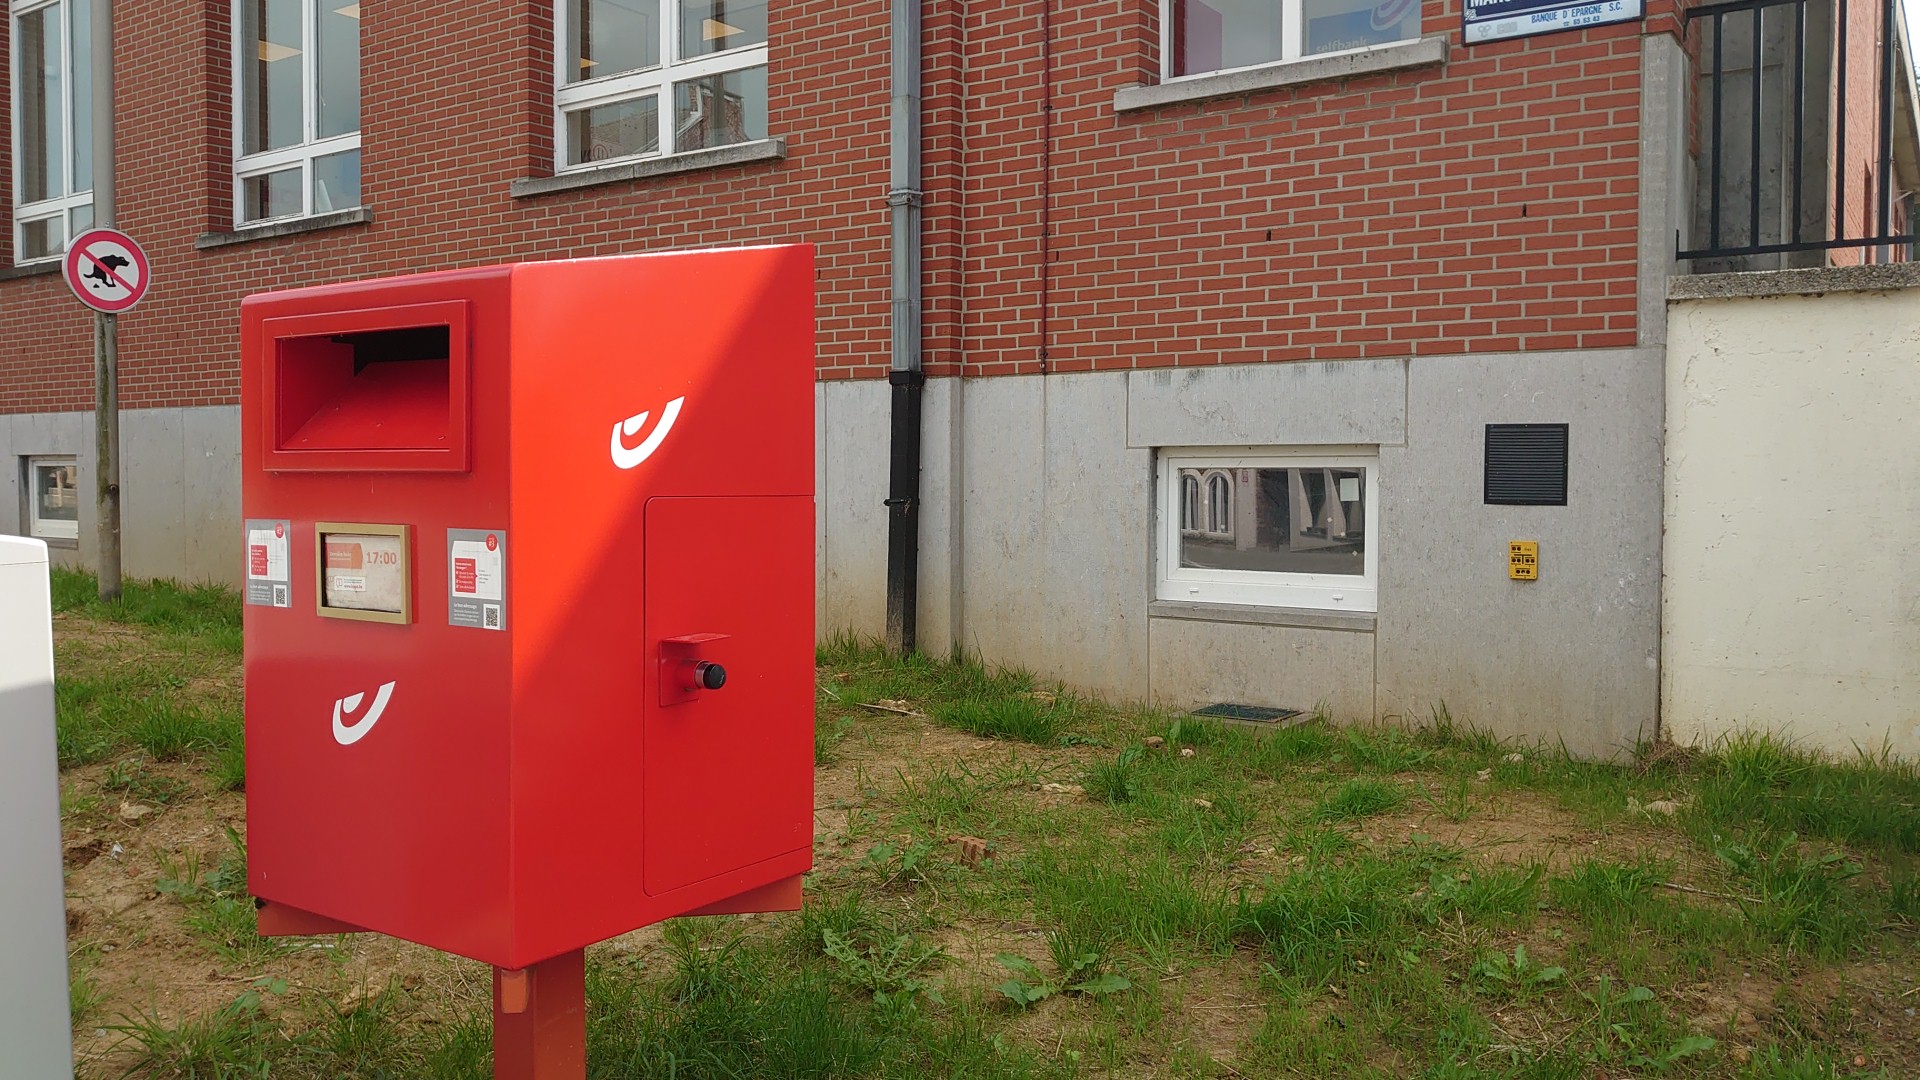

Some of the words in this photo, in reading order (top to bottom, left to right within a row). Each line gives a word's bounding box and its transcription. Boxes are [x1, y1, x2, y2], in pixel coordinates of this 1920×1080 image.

[1531, 12, 1558, 24] BANQUE
[1608, 2, 1623, 12] S.C.
[1316, 36, 1367, 53] selfbank
[366, 551, 397, 565] 17:00
